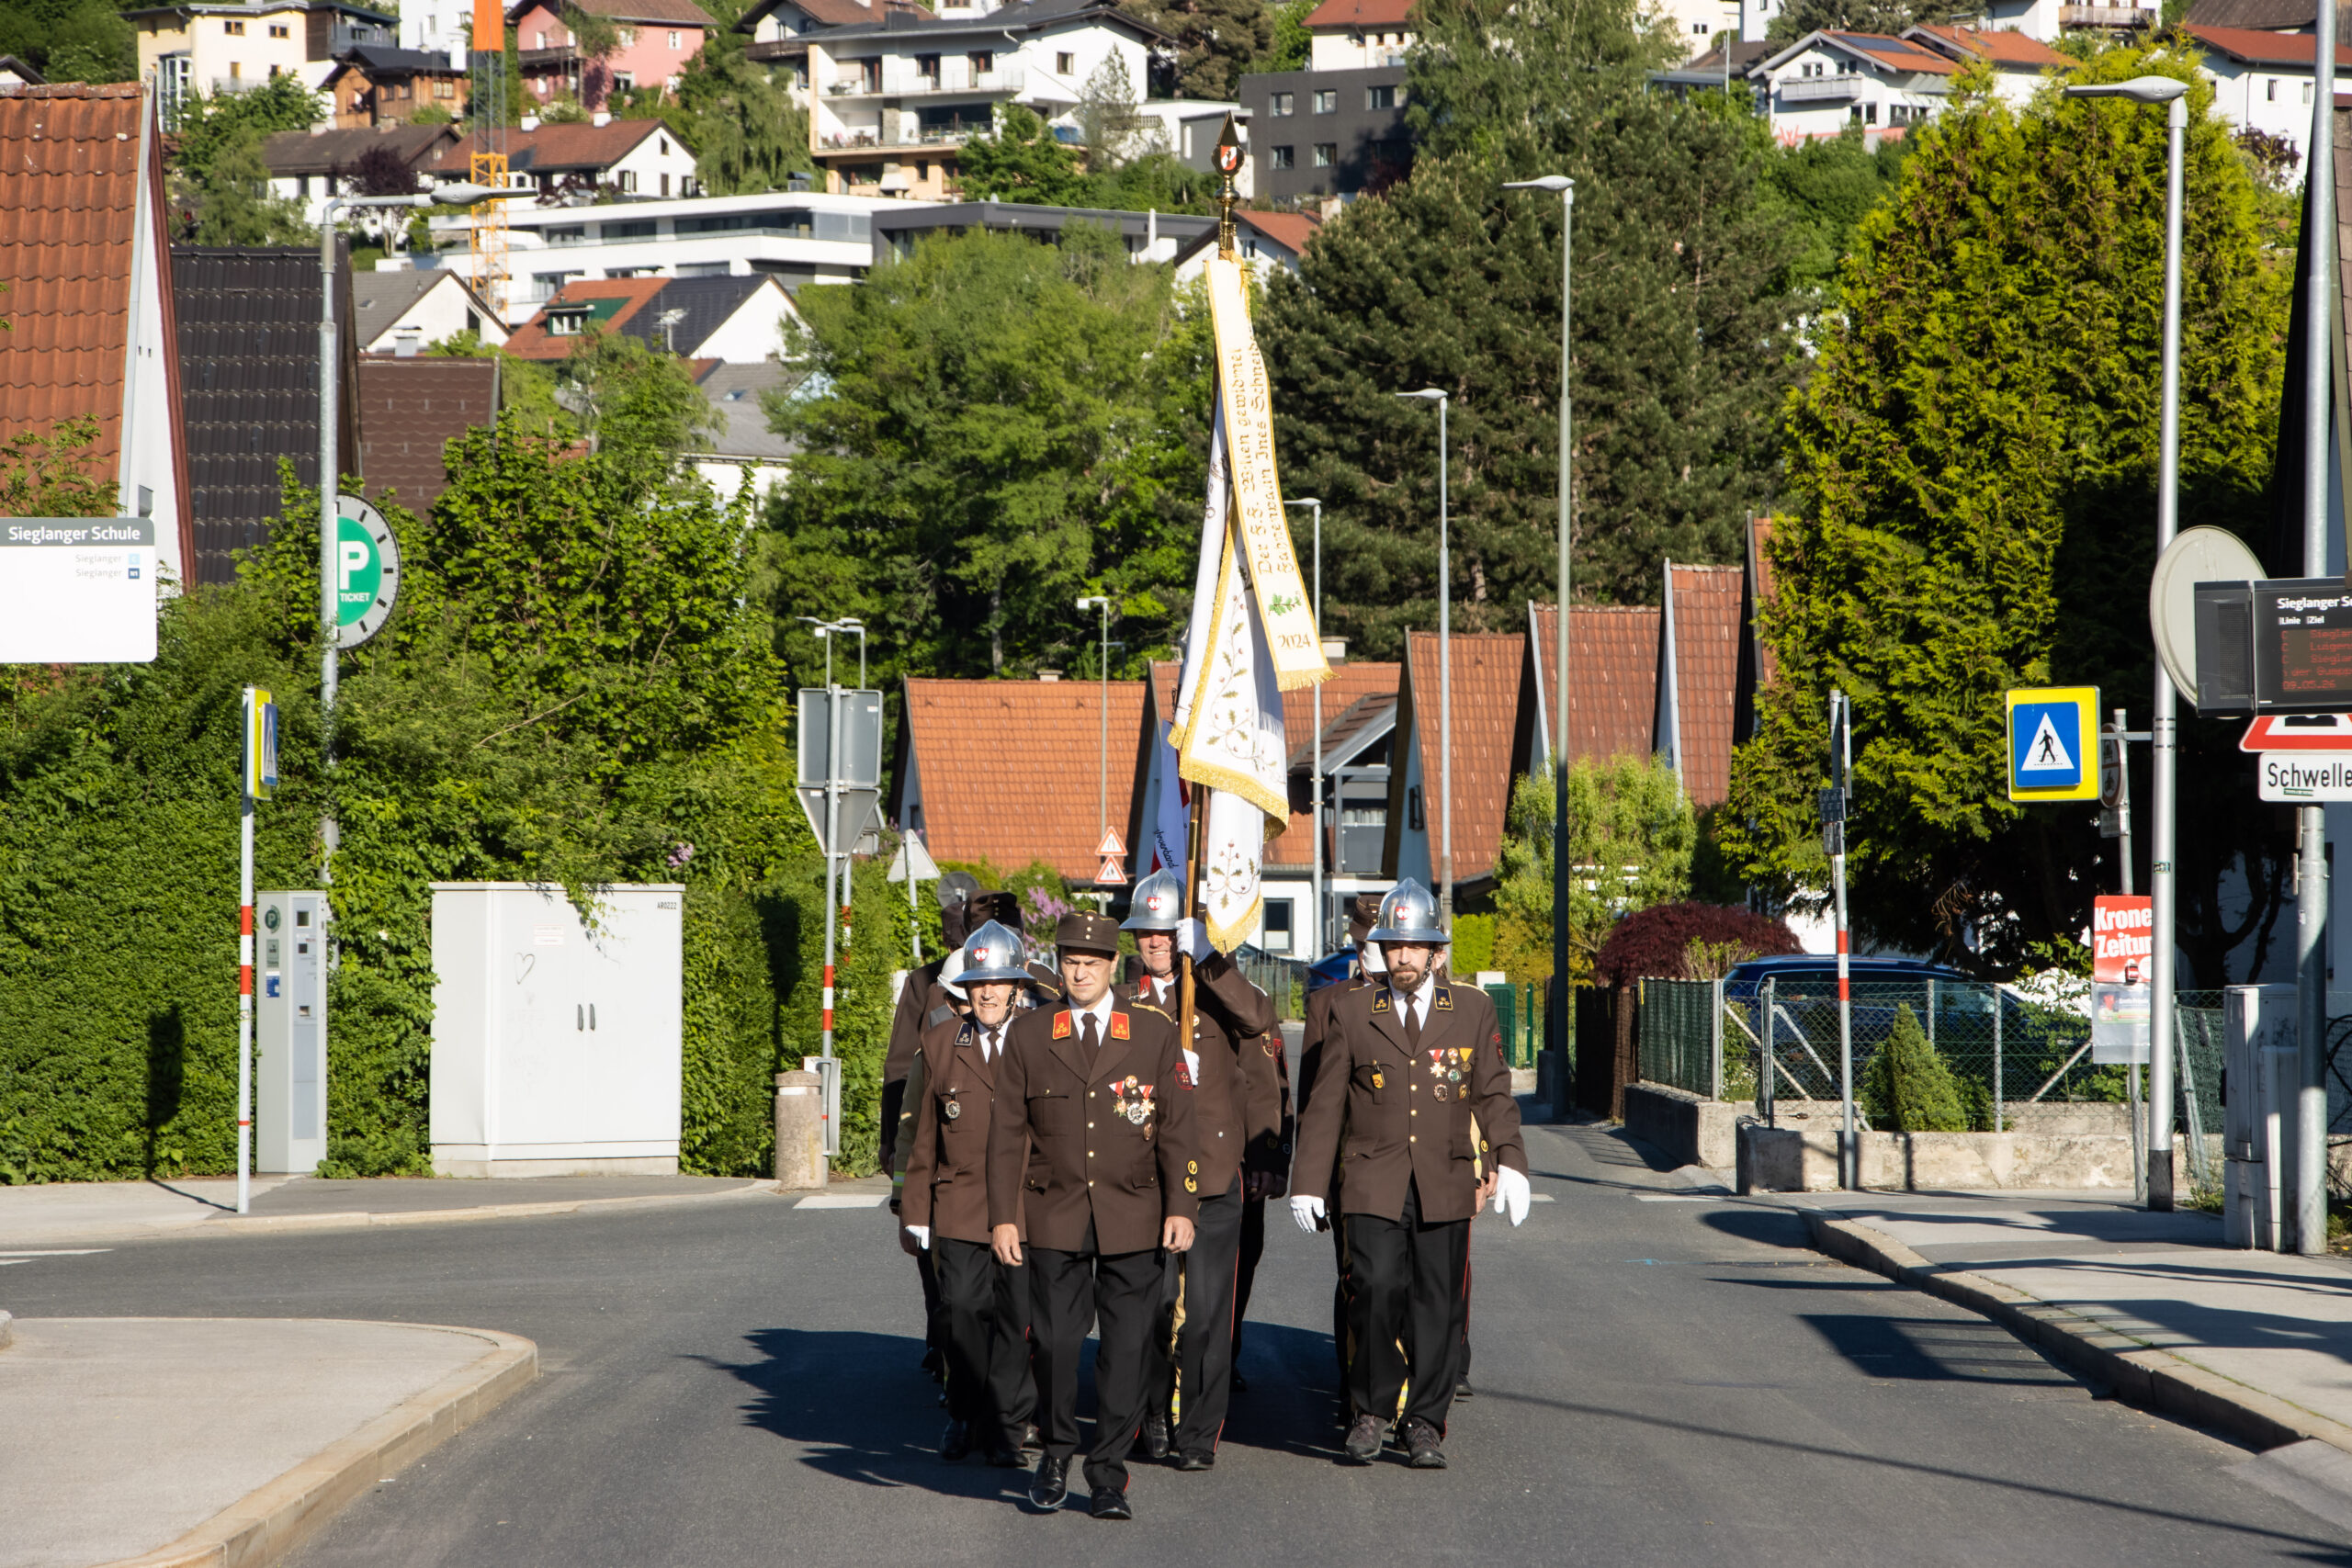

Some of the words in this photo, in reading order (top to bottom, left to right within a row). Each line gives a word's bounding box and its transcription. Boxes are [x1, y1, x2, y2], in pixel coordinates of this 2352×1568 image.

[8, 526, 88, 544] Sieglanger
[91, 526, 141, 540] Schule
[75, 554, 121, 565] Sieglanger
[339, 540, 370, 590] P
[75, 569, 122, 579] Sieglanger
[339, 592, 370, 603] TICKET
[2277, 597, 2339, 612] Sieglanger
[2340, 596, 2352, 607] S
[2309, 615, 2324, 624] Ziel
[1278, 633, 1311, 649] 2024
[2268, 762, 2352, 787] Schwelle
[2095, 907, 2152, 931] Krone
